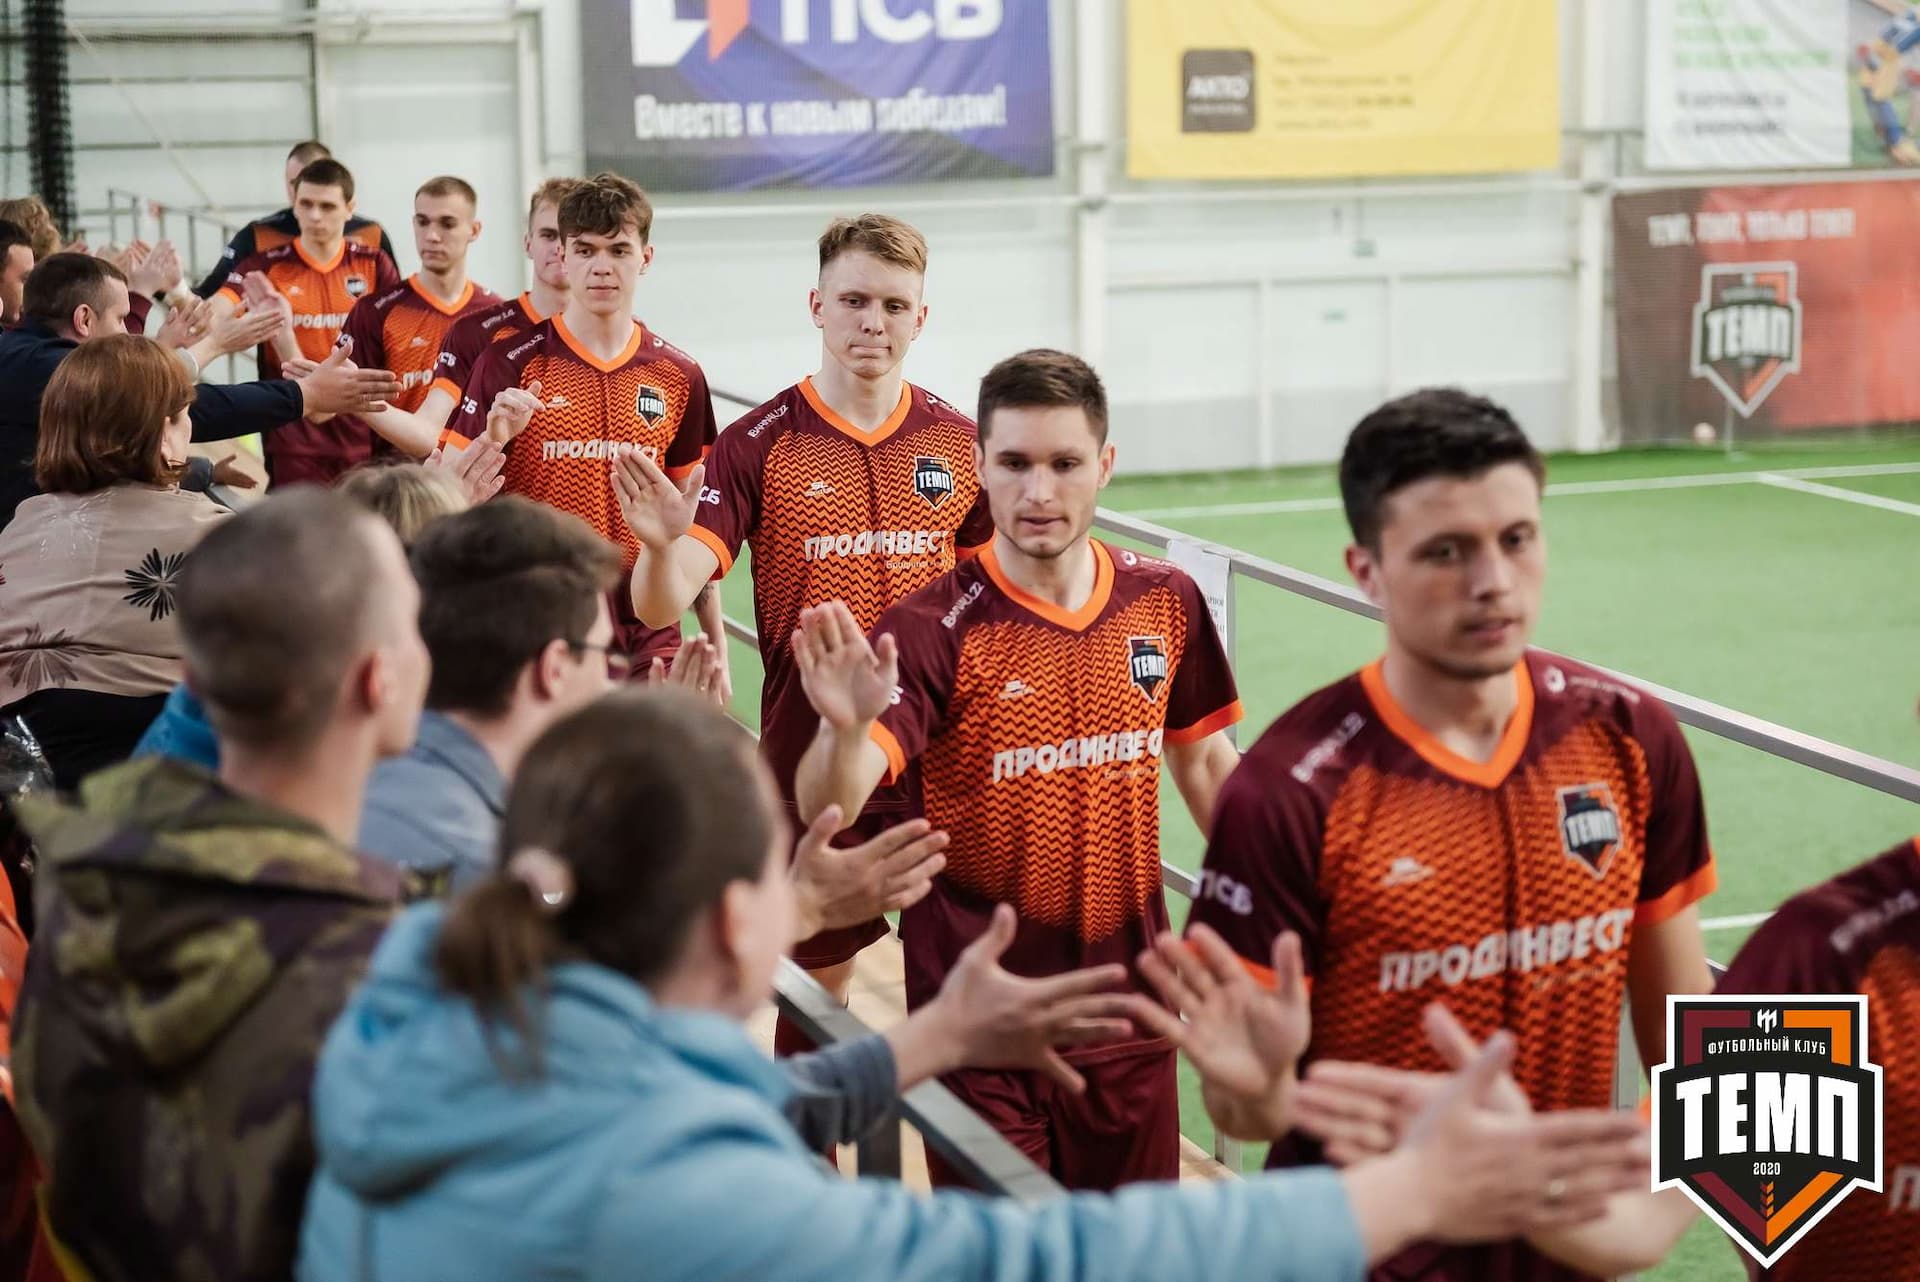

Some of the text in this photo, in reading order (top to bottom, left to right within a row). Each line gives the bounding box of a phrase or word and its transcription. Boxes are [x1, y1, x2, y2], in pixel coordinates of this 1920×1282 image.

[1706, 305, 1793, 362] ТЕМП
[639, 397, 663, 415] ТЕМП
[917, 470, 951, 491] ТЕМП
[1132, 653, 1166, 679] ТЕМП
[1565, 810, 1618, 848] ТЕМП
